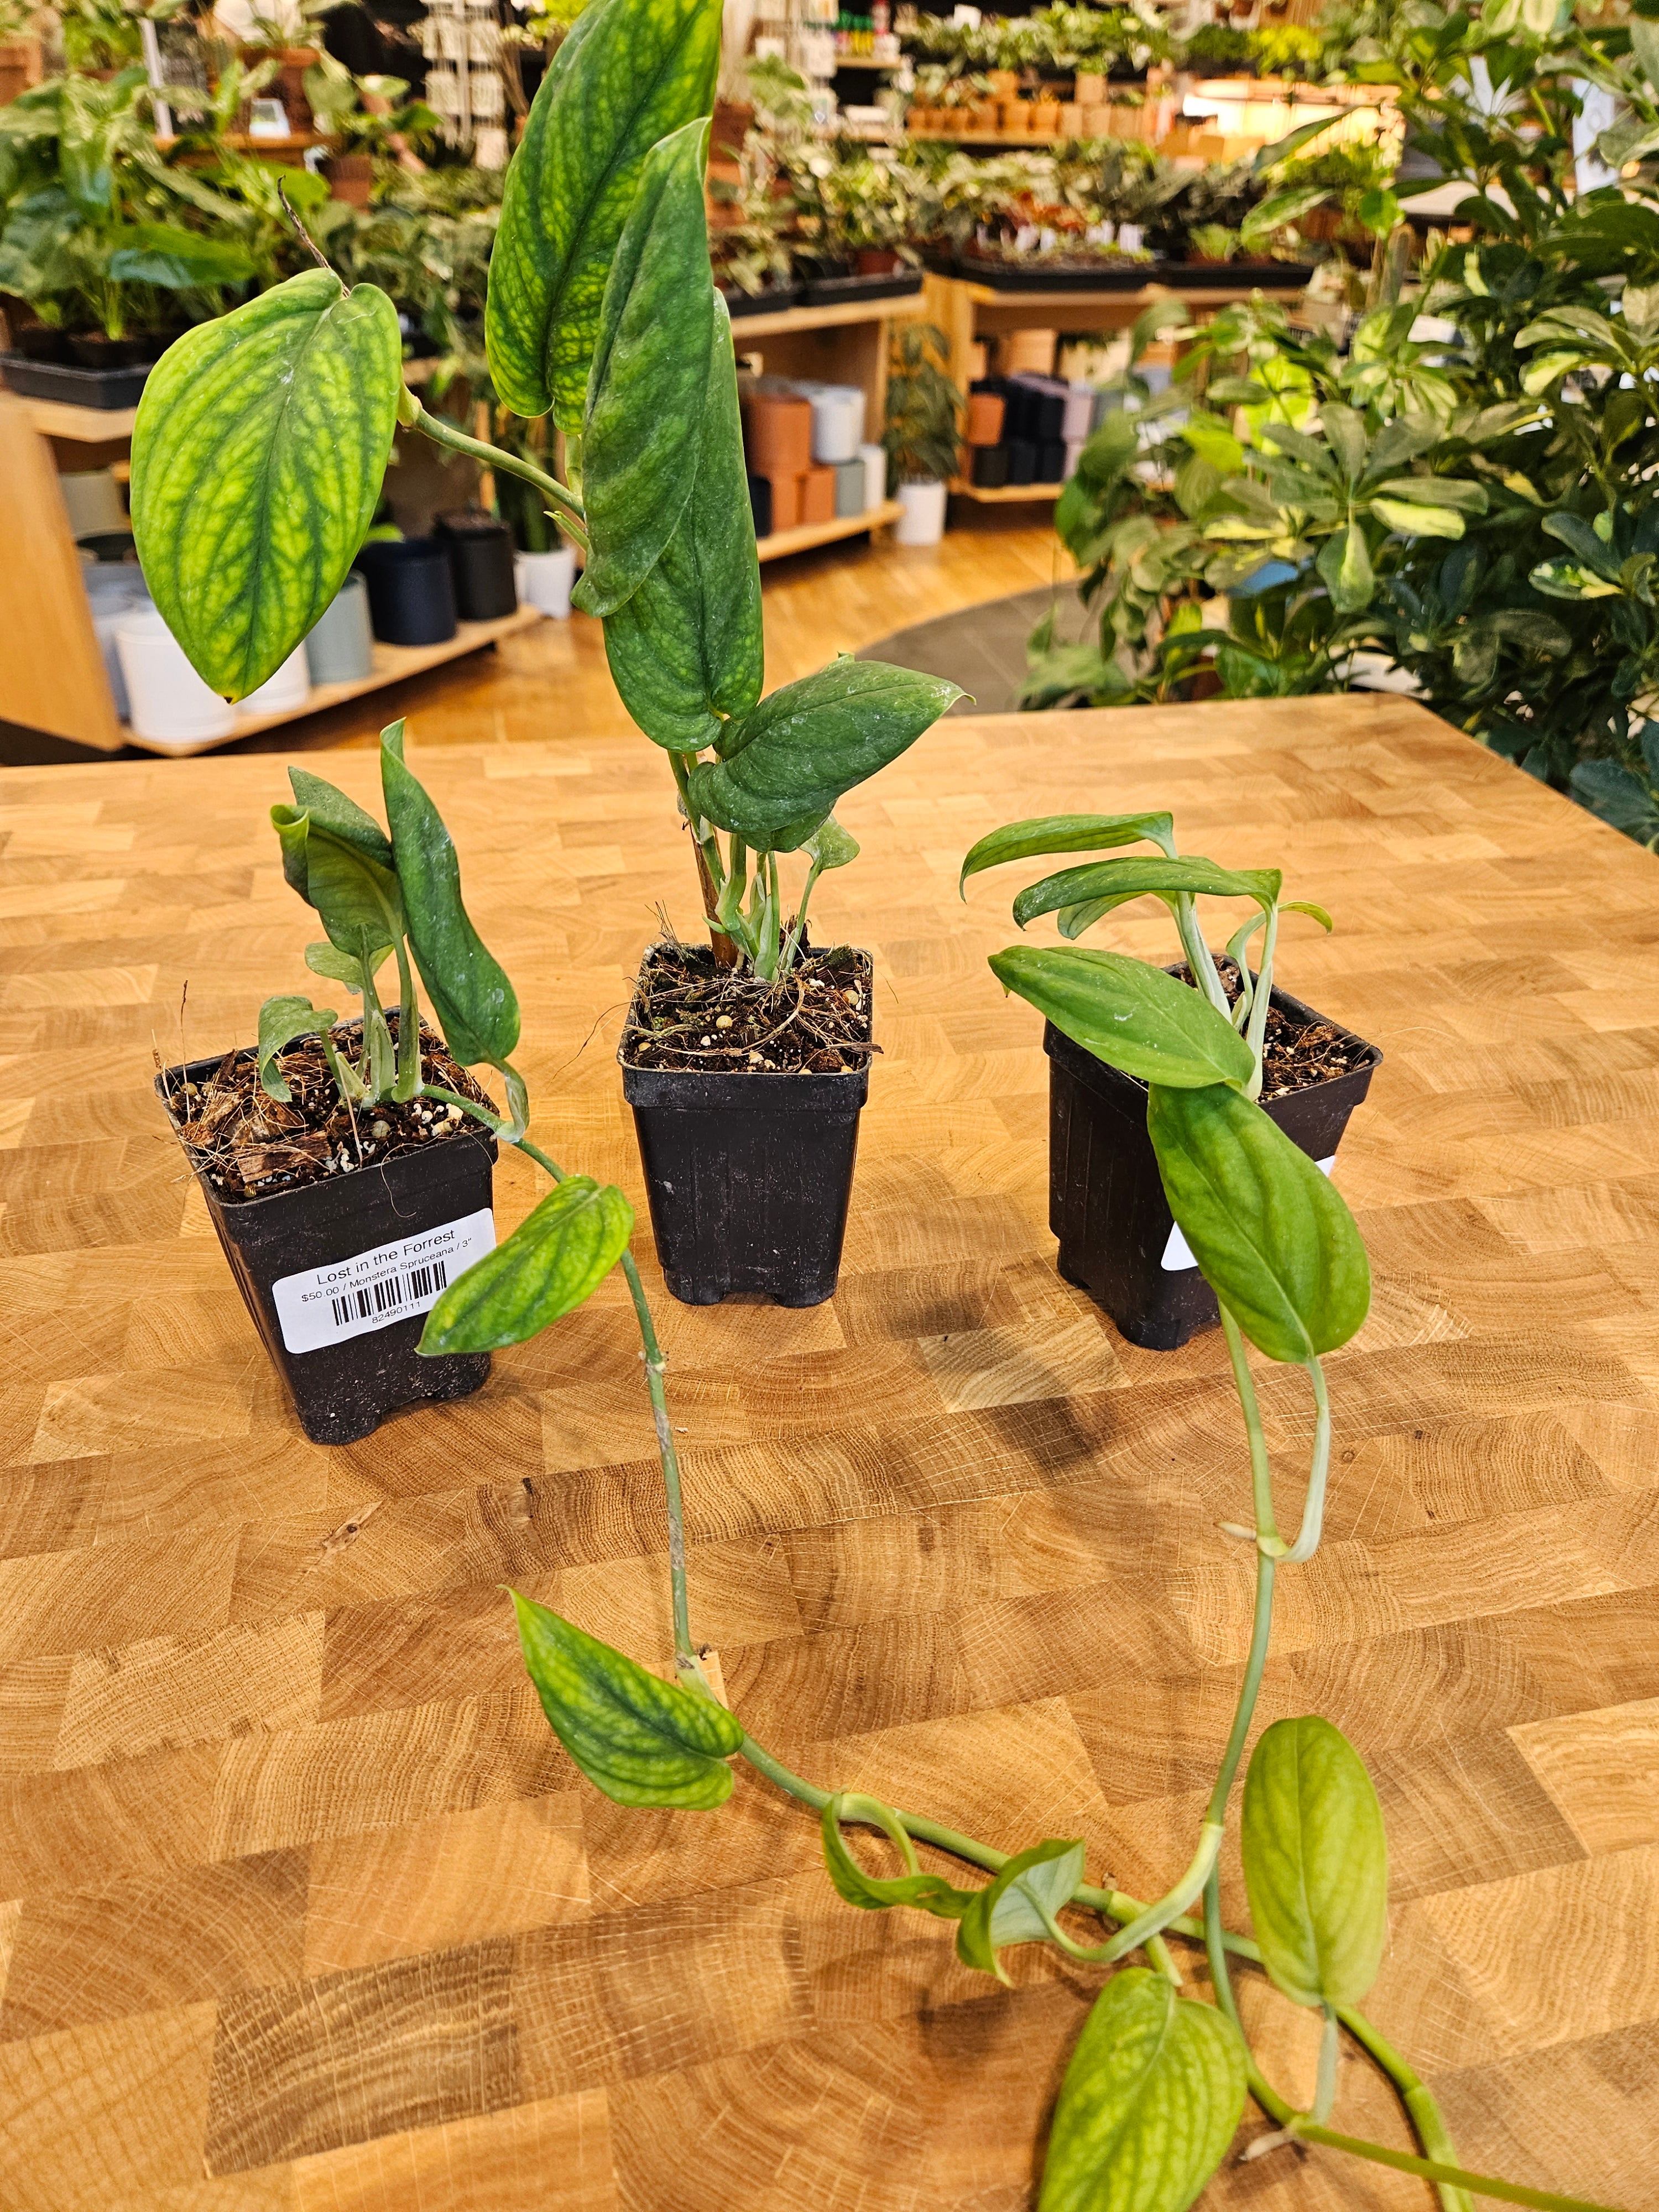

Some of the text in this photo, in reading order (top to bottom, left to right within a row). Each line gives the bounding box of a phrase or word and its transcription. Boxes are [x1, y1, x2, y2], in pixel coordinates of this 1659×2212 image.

[301, 1287, 339, 1302] $50.00
[351, 1266, 397, 1288] Monstera
[400, 1247, 453, 1270] Spruceana
[317, 1230, 455, 1285] Lost in the Forrest
[372, 1302, 420, 1323] 82490111
